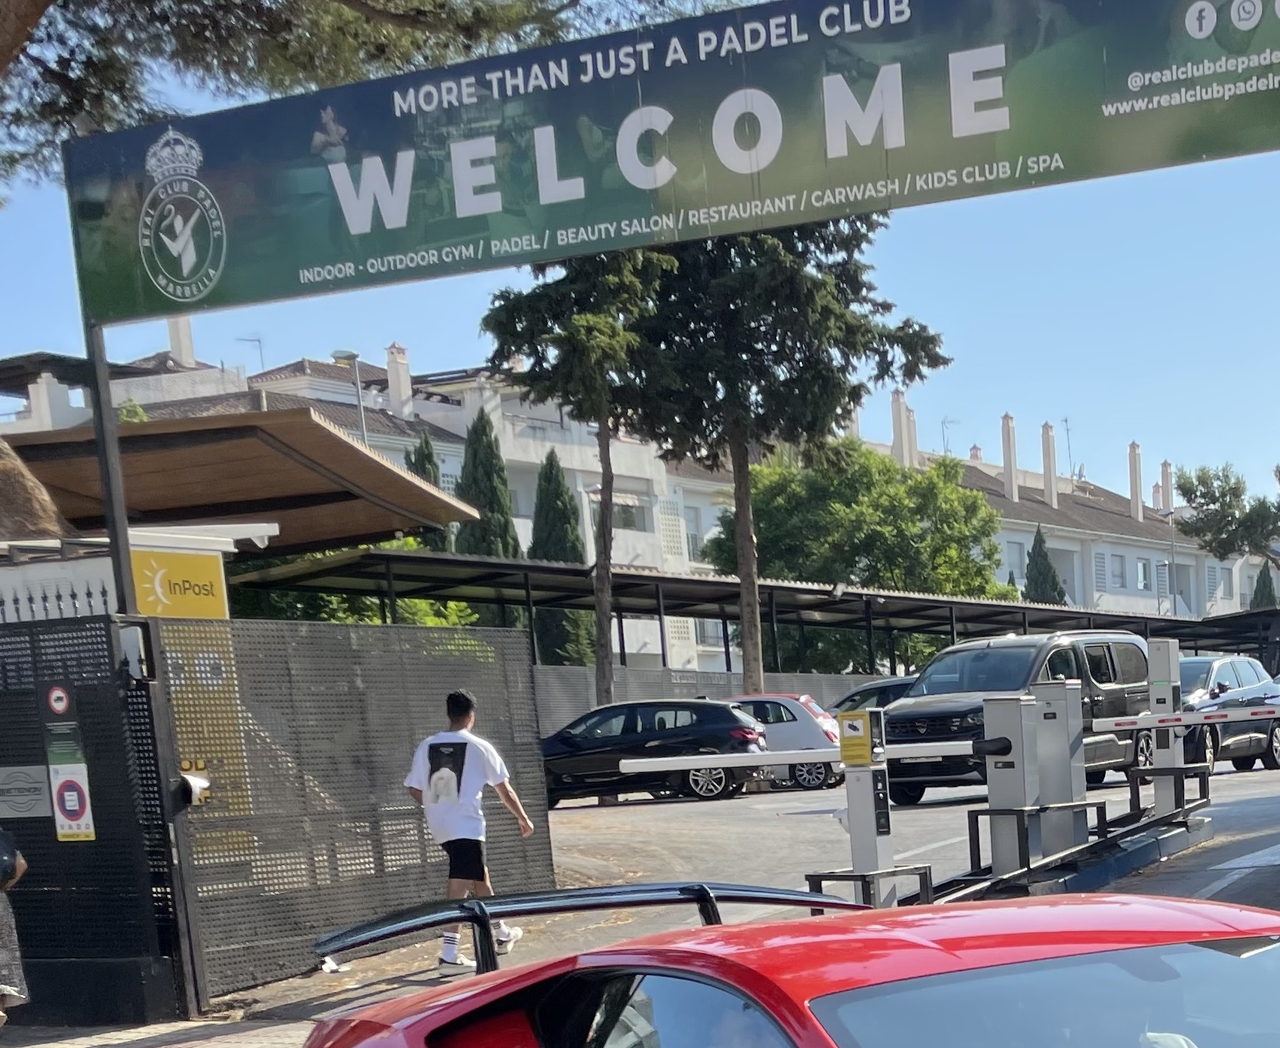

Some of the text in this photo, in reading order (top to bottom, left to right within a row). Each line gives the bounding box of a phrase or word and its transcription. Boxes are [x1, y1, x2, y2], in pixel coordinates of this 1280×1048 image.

[392, 0, 912, 117] MORE THAN JUST A PADEL CLUB
[328, 44, 1011, 236] WELCOME
[142, 181, 223, 247] REAL CLUB PADEL
[299, 263, 355, 284] INDOOR
[366, 252, 439, 274] OUTDOOR
[442, 244, 475, 263] GYM
[490, 234, 541, 256] PADEL
[557, 225, 616, 245] BEAUTY
[621, 215, 674, 235] SALON
[688, 195, 797, 226] RESTAURANT
[811, 178, 899, 207] CARWASH
[915, 170, 958, 191] KIDS
[962, 161, 1011, 184] CLUB
[1026, 153, 1064, 174] SPA
[157, 267, 217, 298] MARBELLA
[167, 579, 216, 597] InPost
